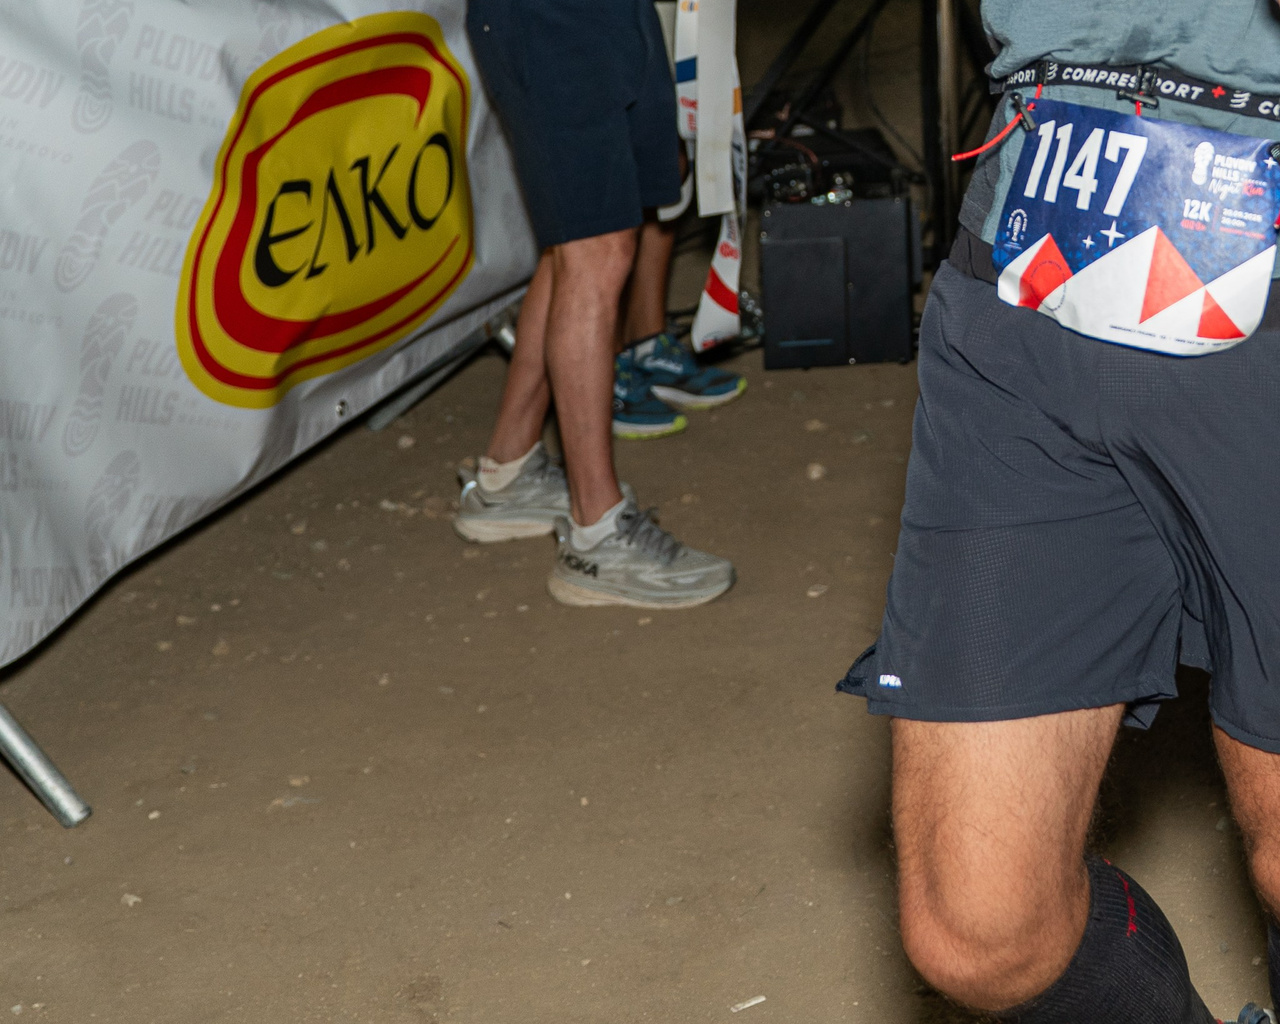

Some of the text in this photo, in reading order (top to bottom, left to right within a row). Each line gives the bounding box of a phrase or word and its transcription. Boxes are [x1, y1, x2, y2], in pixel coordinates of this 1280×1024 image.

[129, 71, 196, 124] HILLS
[1024, 119, 1149, 217] 1147
[1212, 166, 1240, 182] HILLS
[1208, 178, 1243, 201] Night
[1183, 198, 1212, 223] 12K
